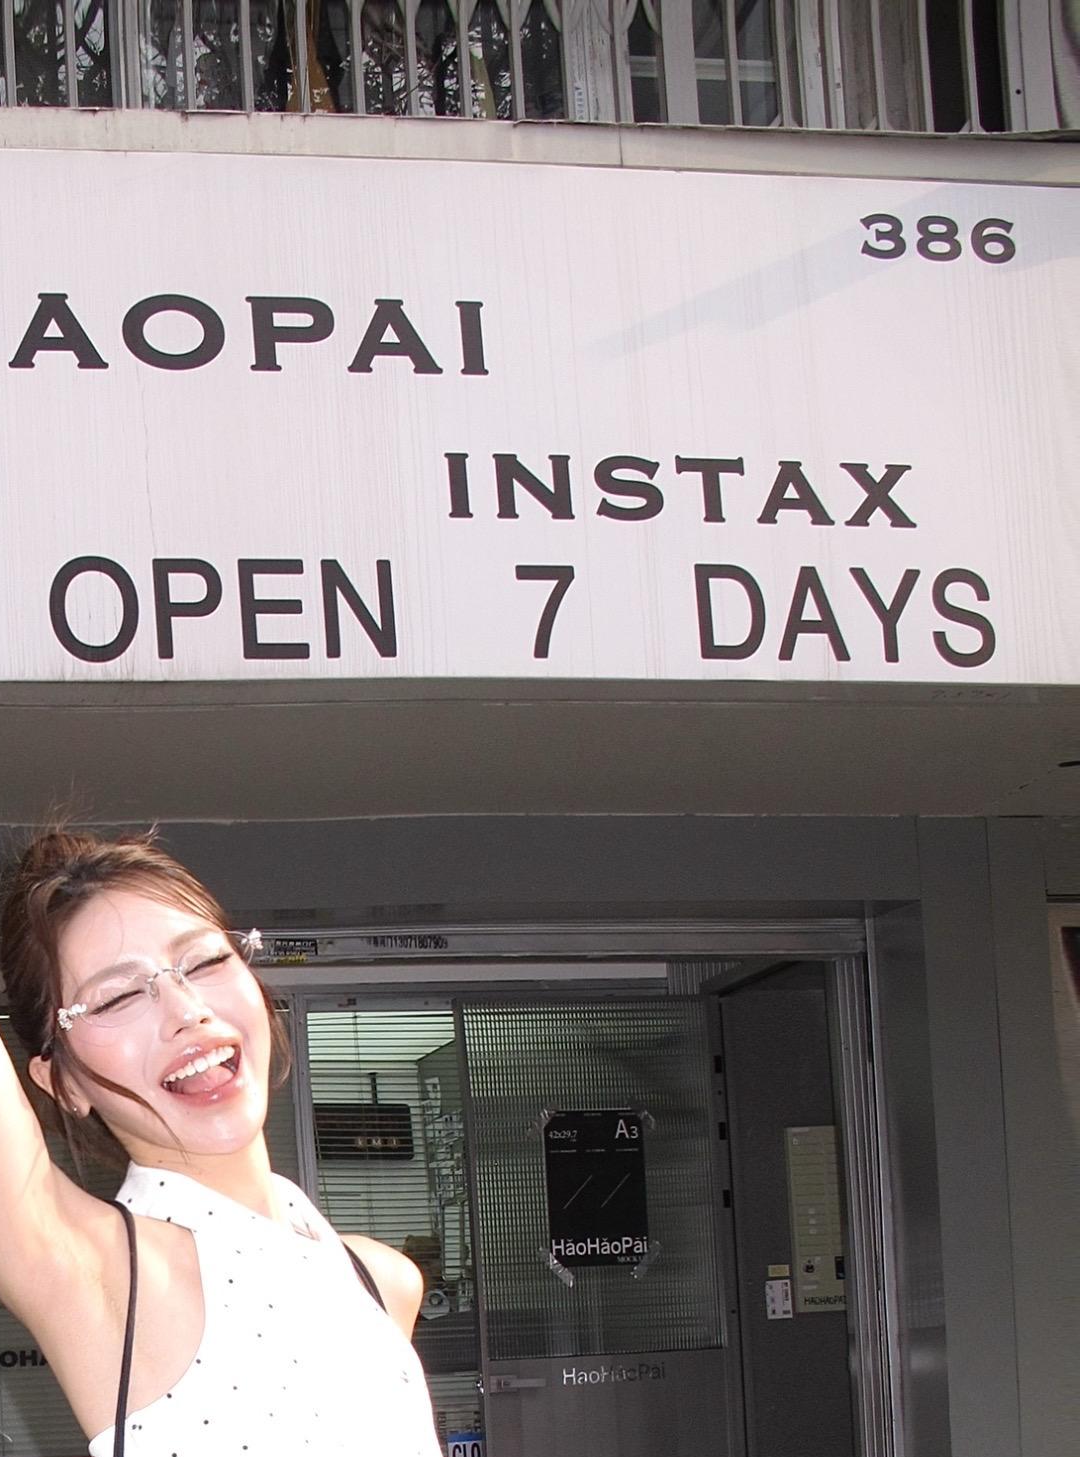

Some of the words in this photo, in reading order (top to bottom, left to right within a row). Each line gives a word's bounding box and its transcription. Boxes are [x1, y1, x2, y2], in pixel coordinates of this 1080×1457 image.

[860, 213, 1016, 264] 386
[444, 452, 917, 529] INSTAX
[49, 555, 397, 663] OPEN
[515, 564, 575, 659] 7
[694, 563, 996, 668] DAYS
[615, 1119, 639, 1139] A3
